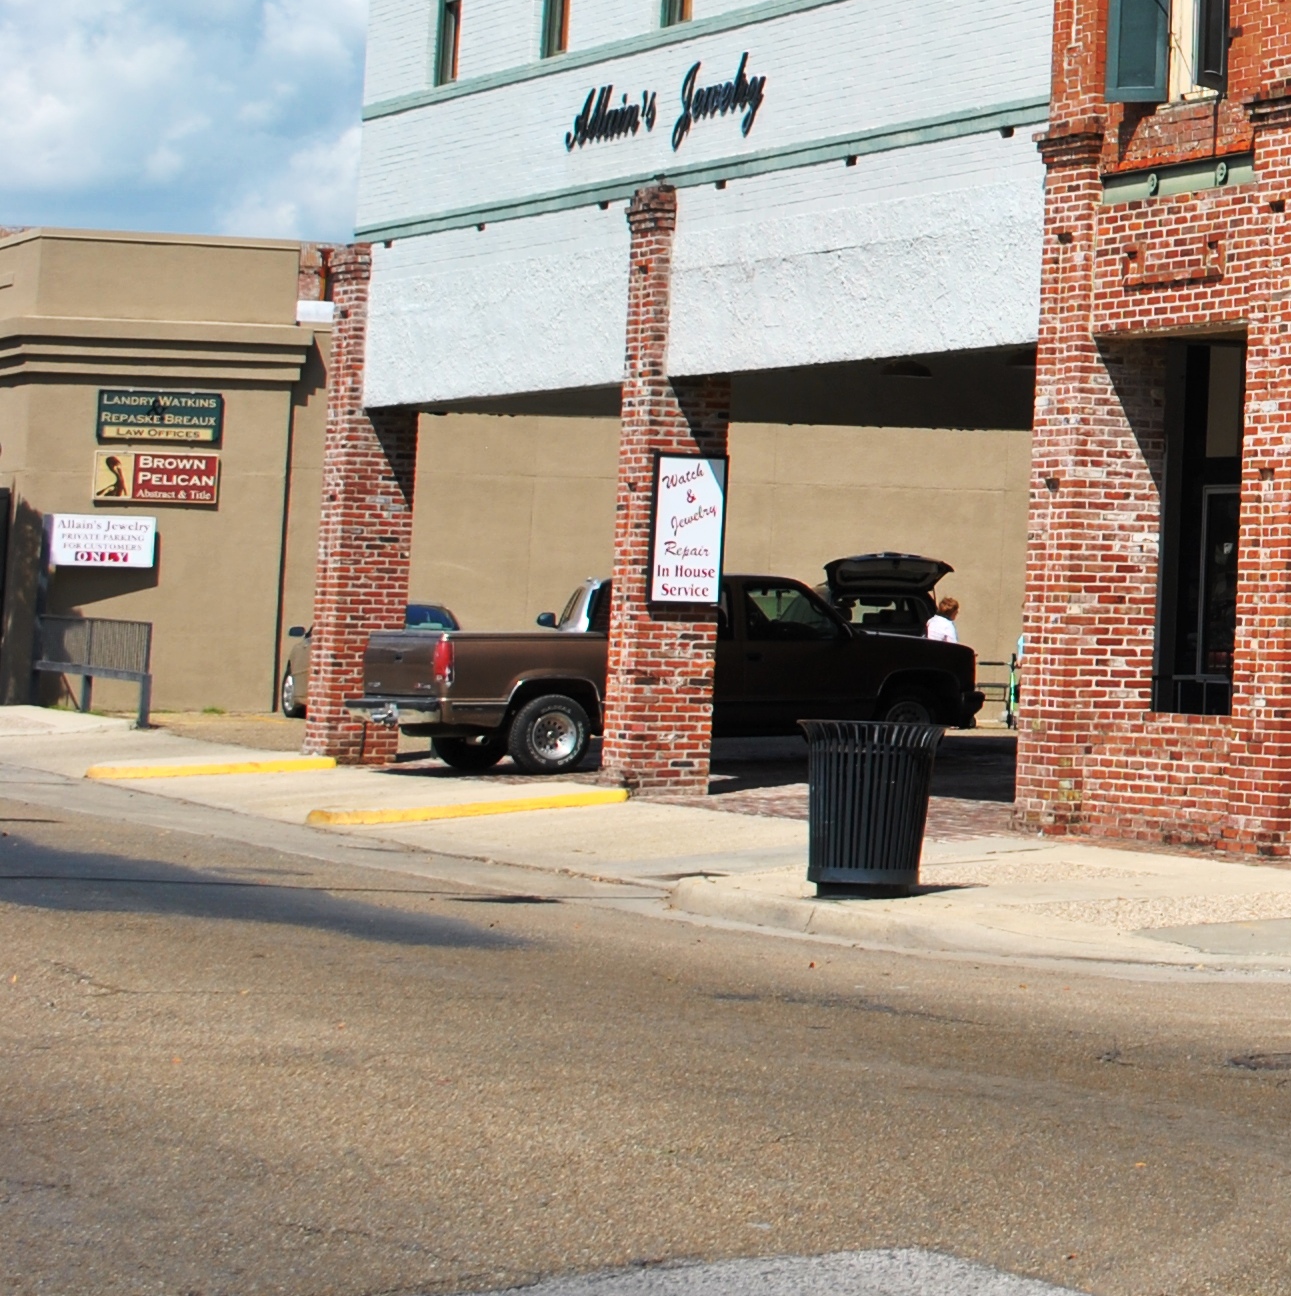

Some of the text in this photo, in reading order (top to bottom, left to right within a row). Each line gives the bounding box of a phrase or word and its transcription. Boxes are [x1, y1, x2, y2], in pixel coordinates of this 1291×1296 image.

[565, 51, 767, 152] Allain's Jewelry
[103, 393, 217, 408] LANDRY WATKINS
[101, 411, 216, 426] REPASKE BREAUX
[116, 428, 200, 438] LAW OFFICES
[139, 455, 206, 470] BROWN
[138, 471, 214, 486] PELICAN
[661, 463, 704, 489] Watch
[136, 489, 211, 500] Abstract & Title
[686, 489, 697, 504] &
[58, 519, 150, 533] Allain's Jewelry
[670, 504, 717, 536] Jewelry
[84, 543, 142, 551] CUSTOMERS
[664, 540, 711, 560] Repair
[75, 551, 130, 562] ONLY
[657, 564, 716, 579] In House
[661, 583, 709, 597] Service
